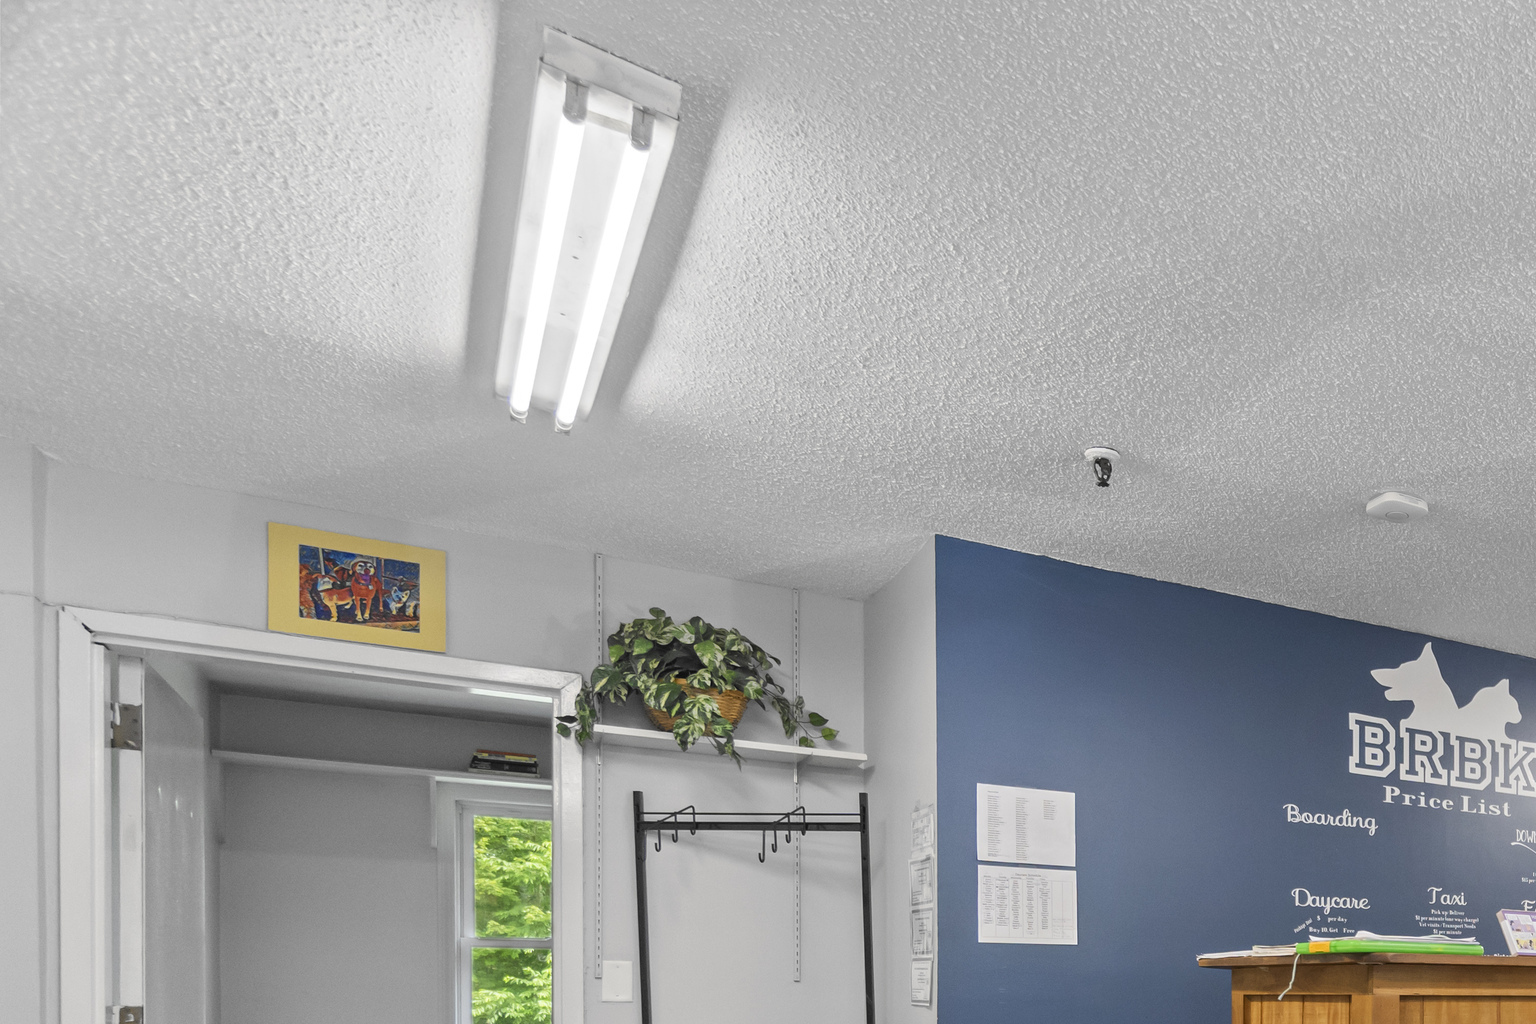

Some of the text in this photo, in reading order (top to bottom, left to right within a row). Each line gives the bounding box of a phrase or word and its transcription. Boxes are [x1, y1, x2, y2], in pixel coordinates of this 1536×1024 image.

[1382, 785, 1512, 817] Price List
[1283, 804, 1378, 836] Boarding
[1291, 888, 1370, 914] Daycare
[1428, 886, 1467, 906] Taxi
